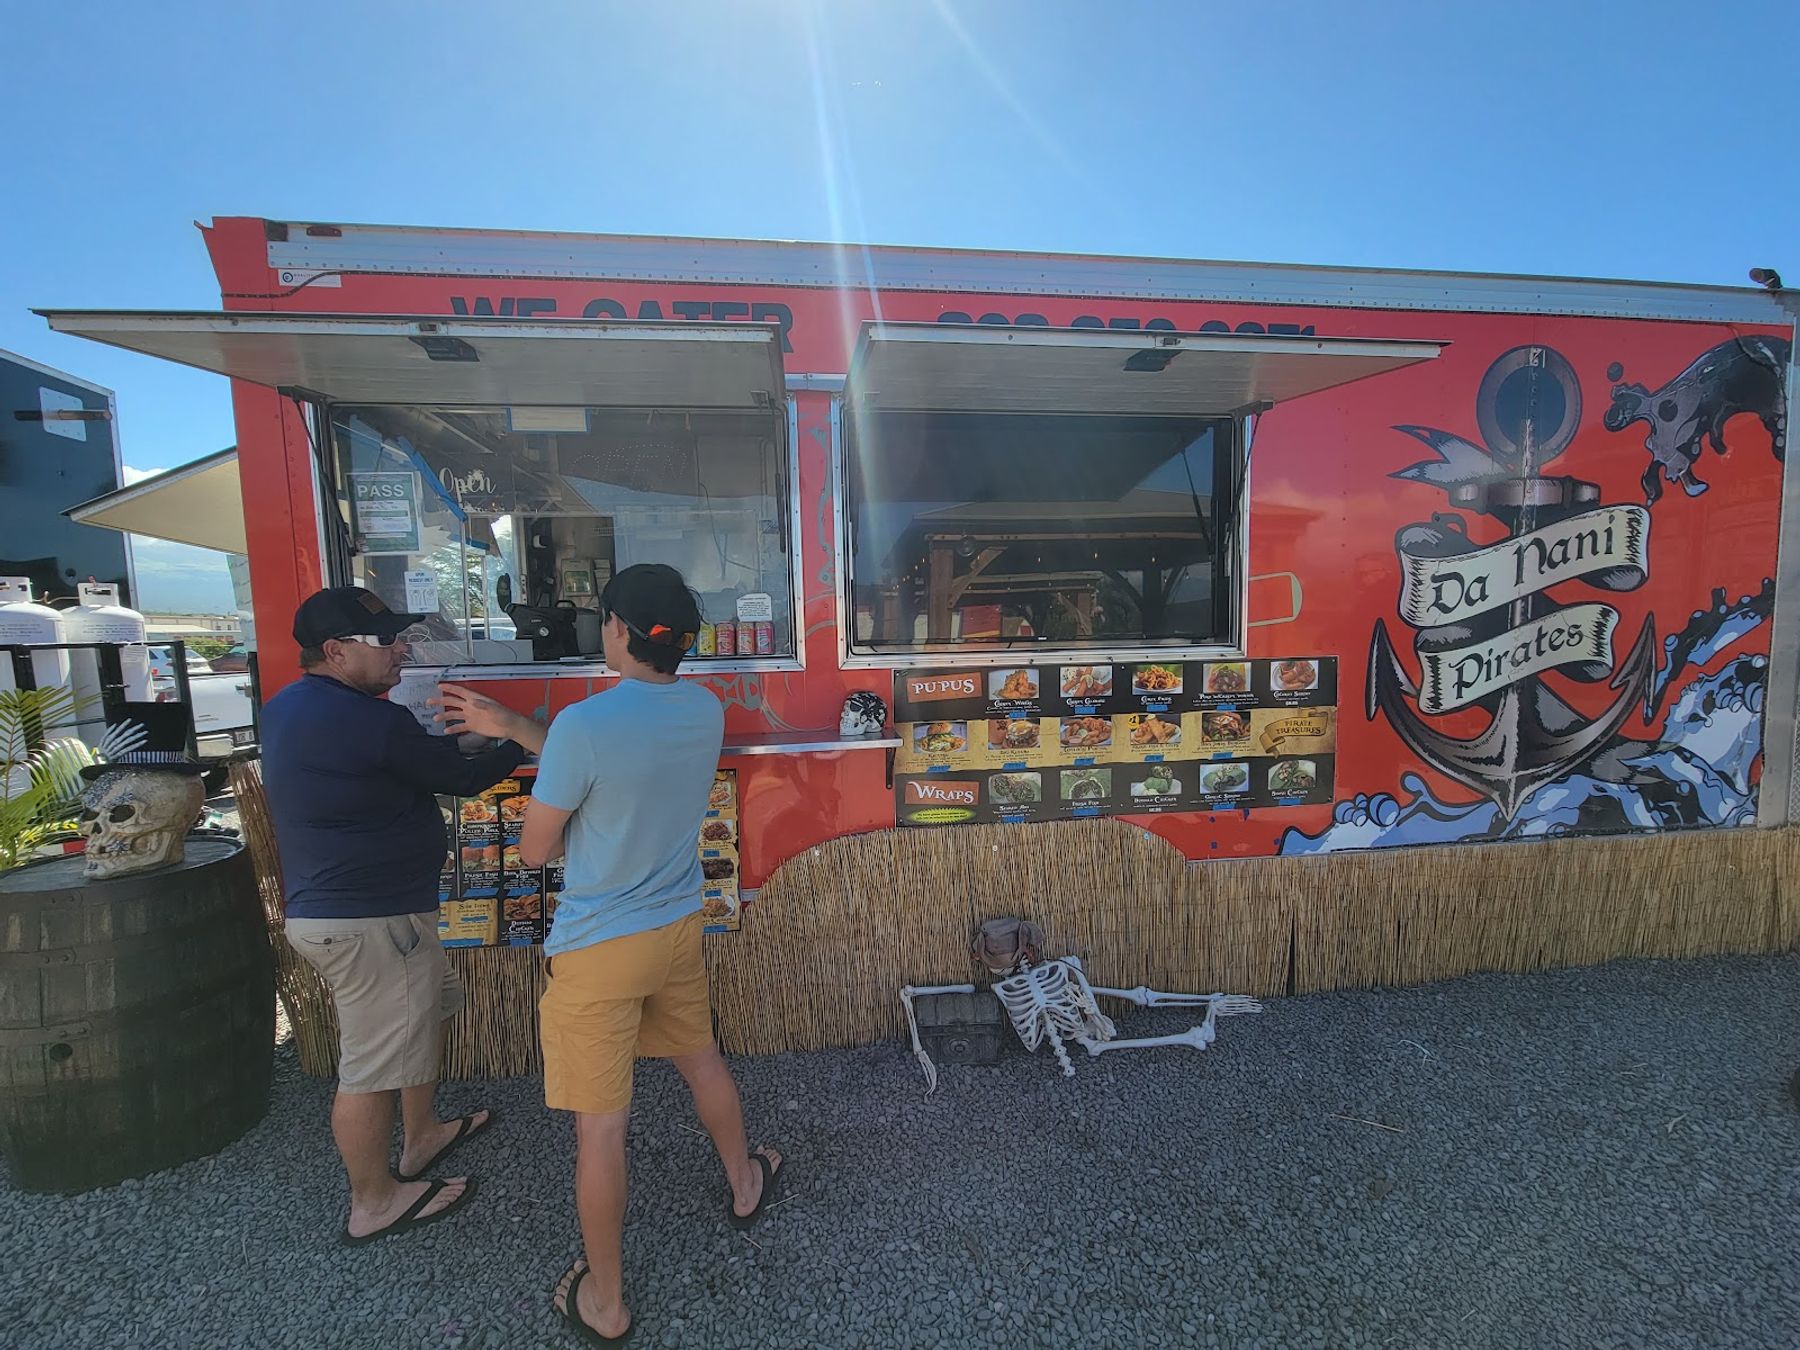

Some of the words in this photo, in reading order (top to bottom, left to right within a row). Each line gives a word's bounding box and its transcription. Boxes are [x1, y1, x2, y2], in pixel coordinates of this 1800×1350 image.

[357, 484, 404, 497] PASS
[439, 467, 496, 502] Open
[1427, 571, 1490, 614] Da
[1512, 515, 1615, 587] Nani
[1449, 623, 1586, 699] Pirates
[912, 679, 975, 694] PUPUS
[1276, 726, 1321, 735] TREASURES
[907, 781, 974, 804] WRAPS
